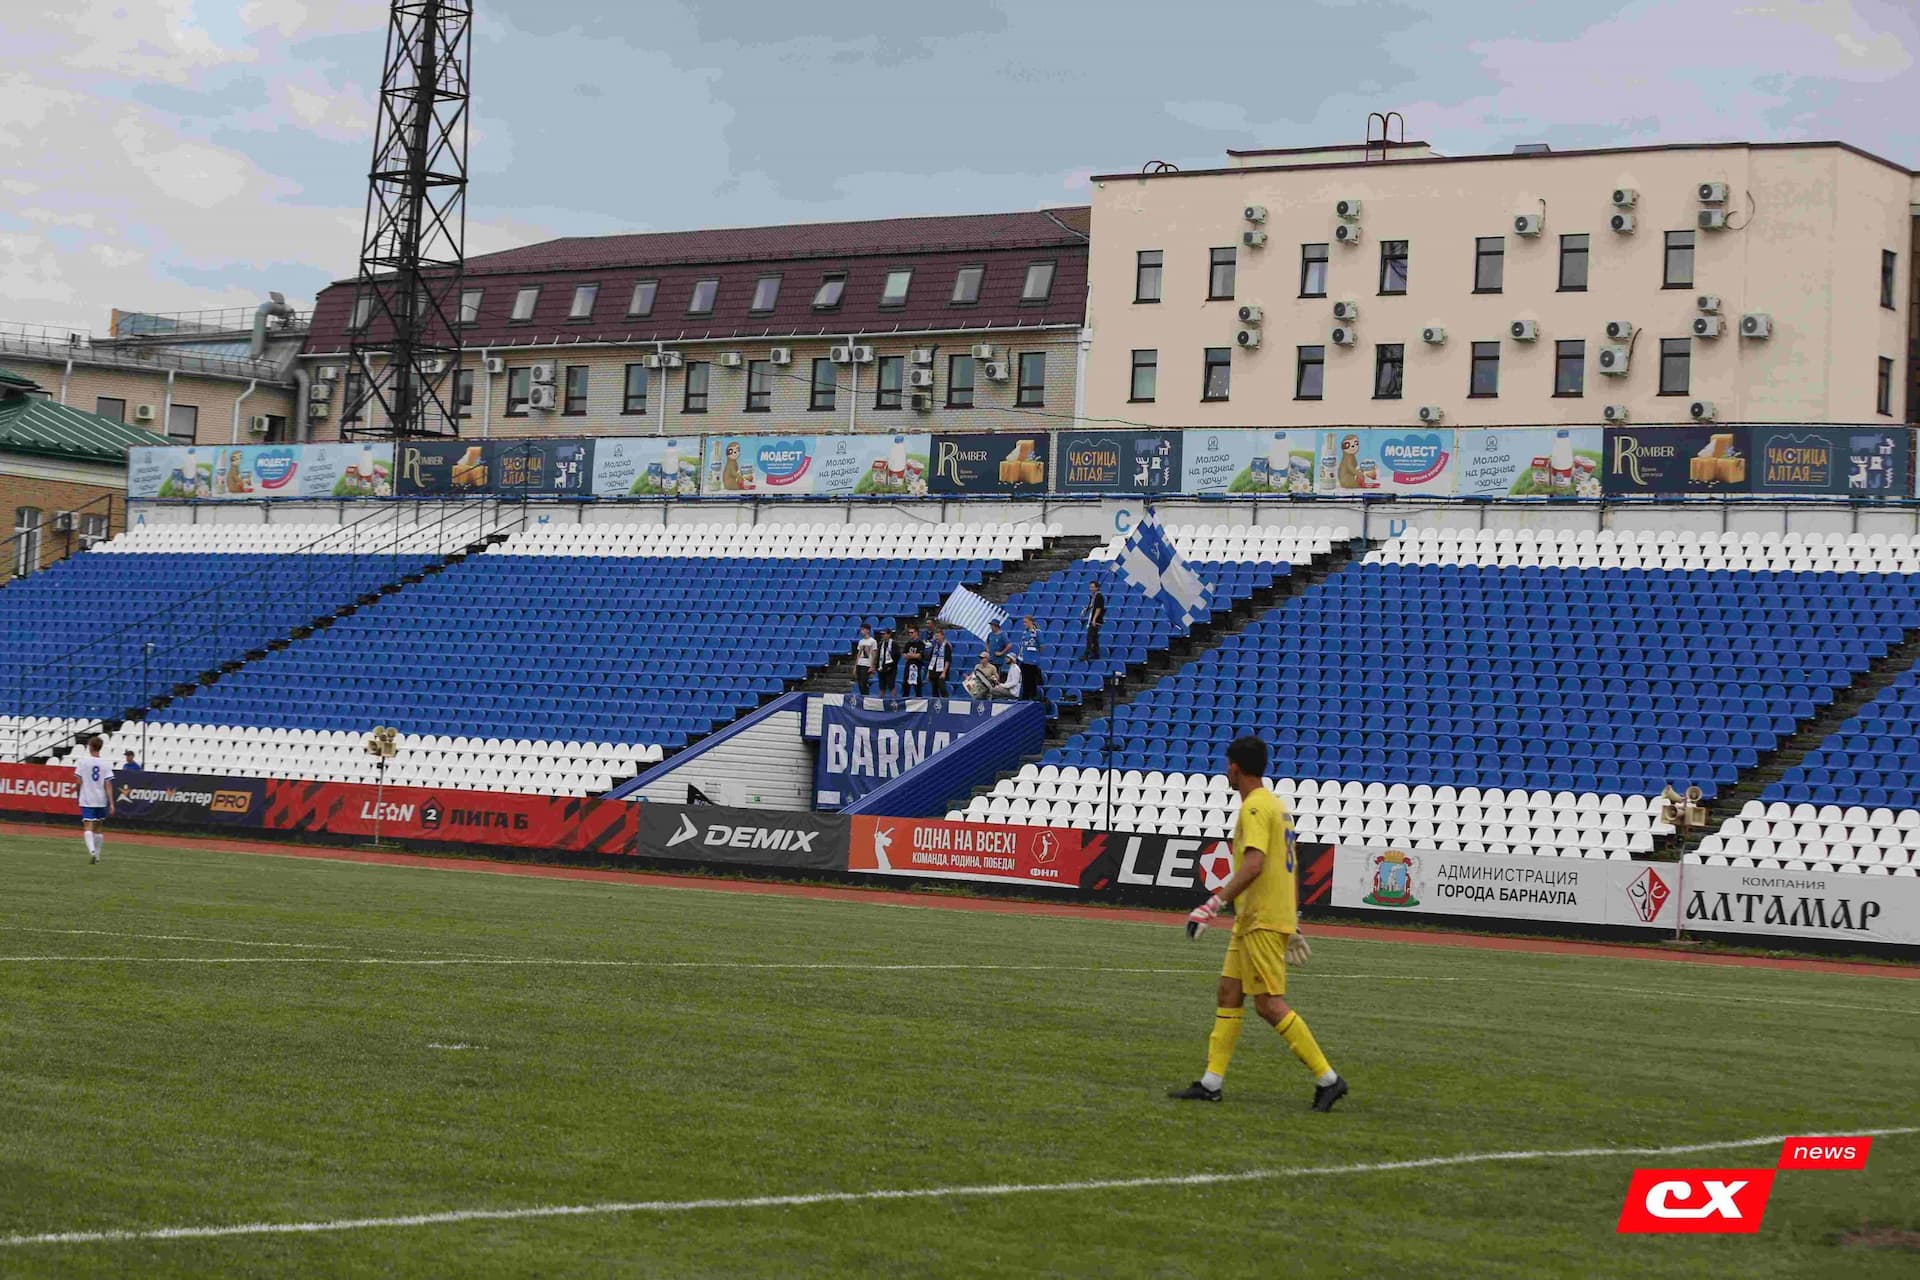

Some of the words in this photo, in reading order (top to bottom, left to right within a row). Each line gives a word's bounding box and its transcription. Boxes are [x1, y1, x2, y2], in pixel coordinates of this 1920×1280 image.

[760, 450, 803, 463] МОДЕСТ
[1069, 451, 1117, 467] ЧАСТИЦА
[1384, 445, 1438, 458] МОДЕСТ
[1611, 435, 1675, 486] ROMBER
[1768, 447, 1828, 466] ЧАСТИЦА
[936, 441, 988, 487] ROMBER
[1069, 467, 1103, 481] АЛТАЯ
[1768, 466, 1811, 482] АЛТАЯ
[827, 723, 967, 778] BARN
[91, 765, 101, 782] 8
[213, 794, 247, 809] PRO
[361, 800, 415, 823] LEON
[425, 808, 439, 821] 2
[450, 811, 510, 829] ЛИГА
[513, 812, 529, 830] Б
[703, 824, 820, 852] DEMIX
[913, 827, 951, 851] ОДНА
[954, 829, 974, 849] НА
[976, 830, 1017, 854] ВСЕХ!
[912, 852, 949, 867] КОМАНДА,
[951, 854, 982, 869] РОДИНА,
[983, 856, 1015, 870] ПОБЕДА!
[1117, 836, 1234, 892] LEO
[1437, 864, 1578, 886] АДМИНИСТРАЦИЯ
[1742, 876, 1825, 890] КОМПАНИЯ
[1437, 884, 1495, 901] ГОРОДА
[1500, 887, 1577, 905] БАРНАУЛА
[1686, 890, 1880, 931] АЛТАМАР
